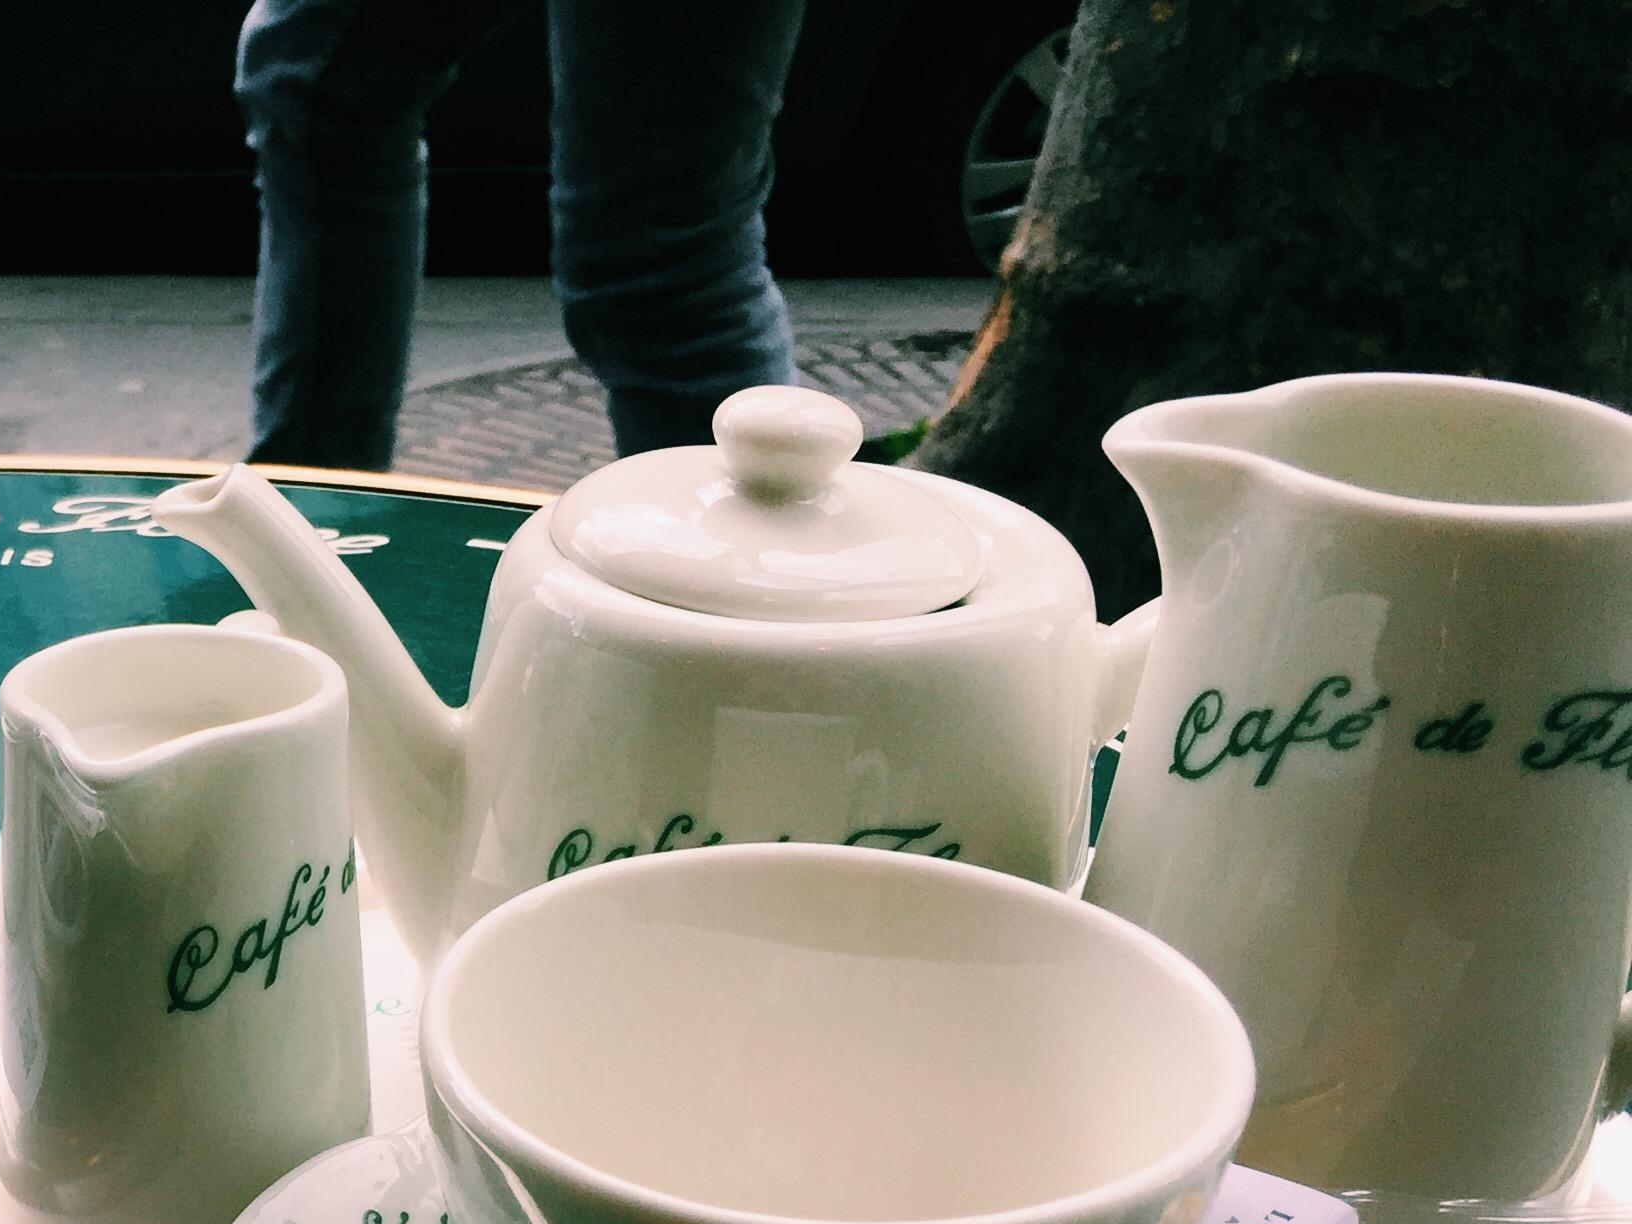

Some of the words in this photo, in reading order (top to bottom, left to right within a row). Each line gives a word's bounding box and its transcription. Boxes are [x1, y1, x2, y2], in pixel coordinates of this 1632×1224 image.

[1168, 675, 1391, 787] Café
[1414, 702, 1495, 752] de
[167, 863, 330, 1014] Café
